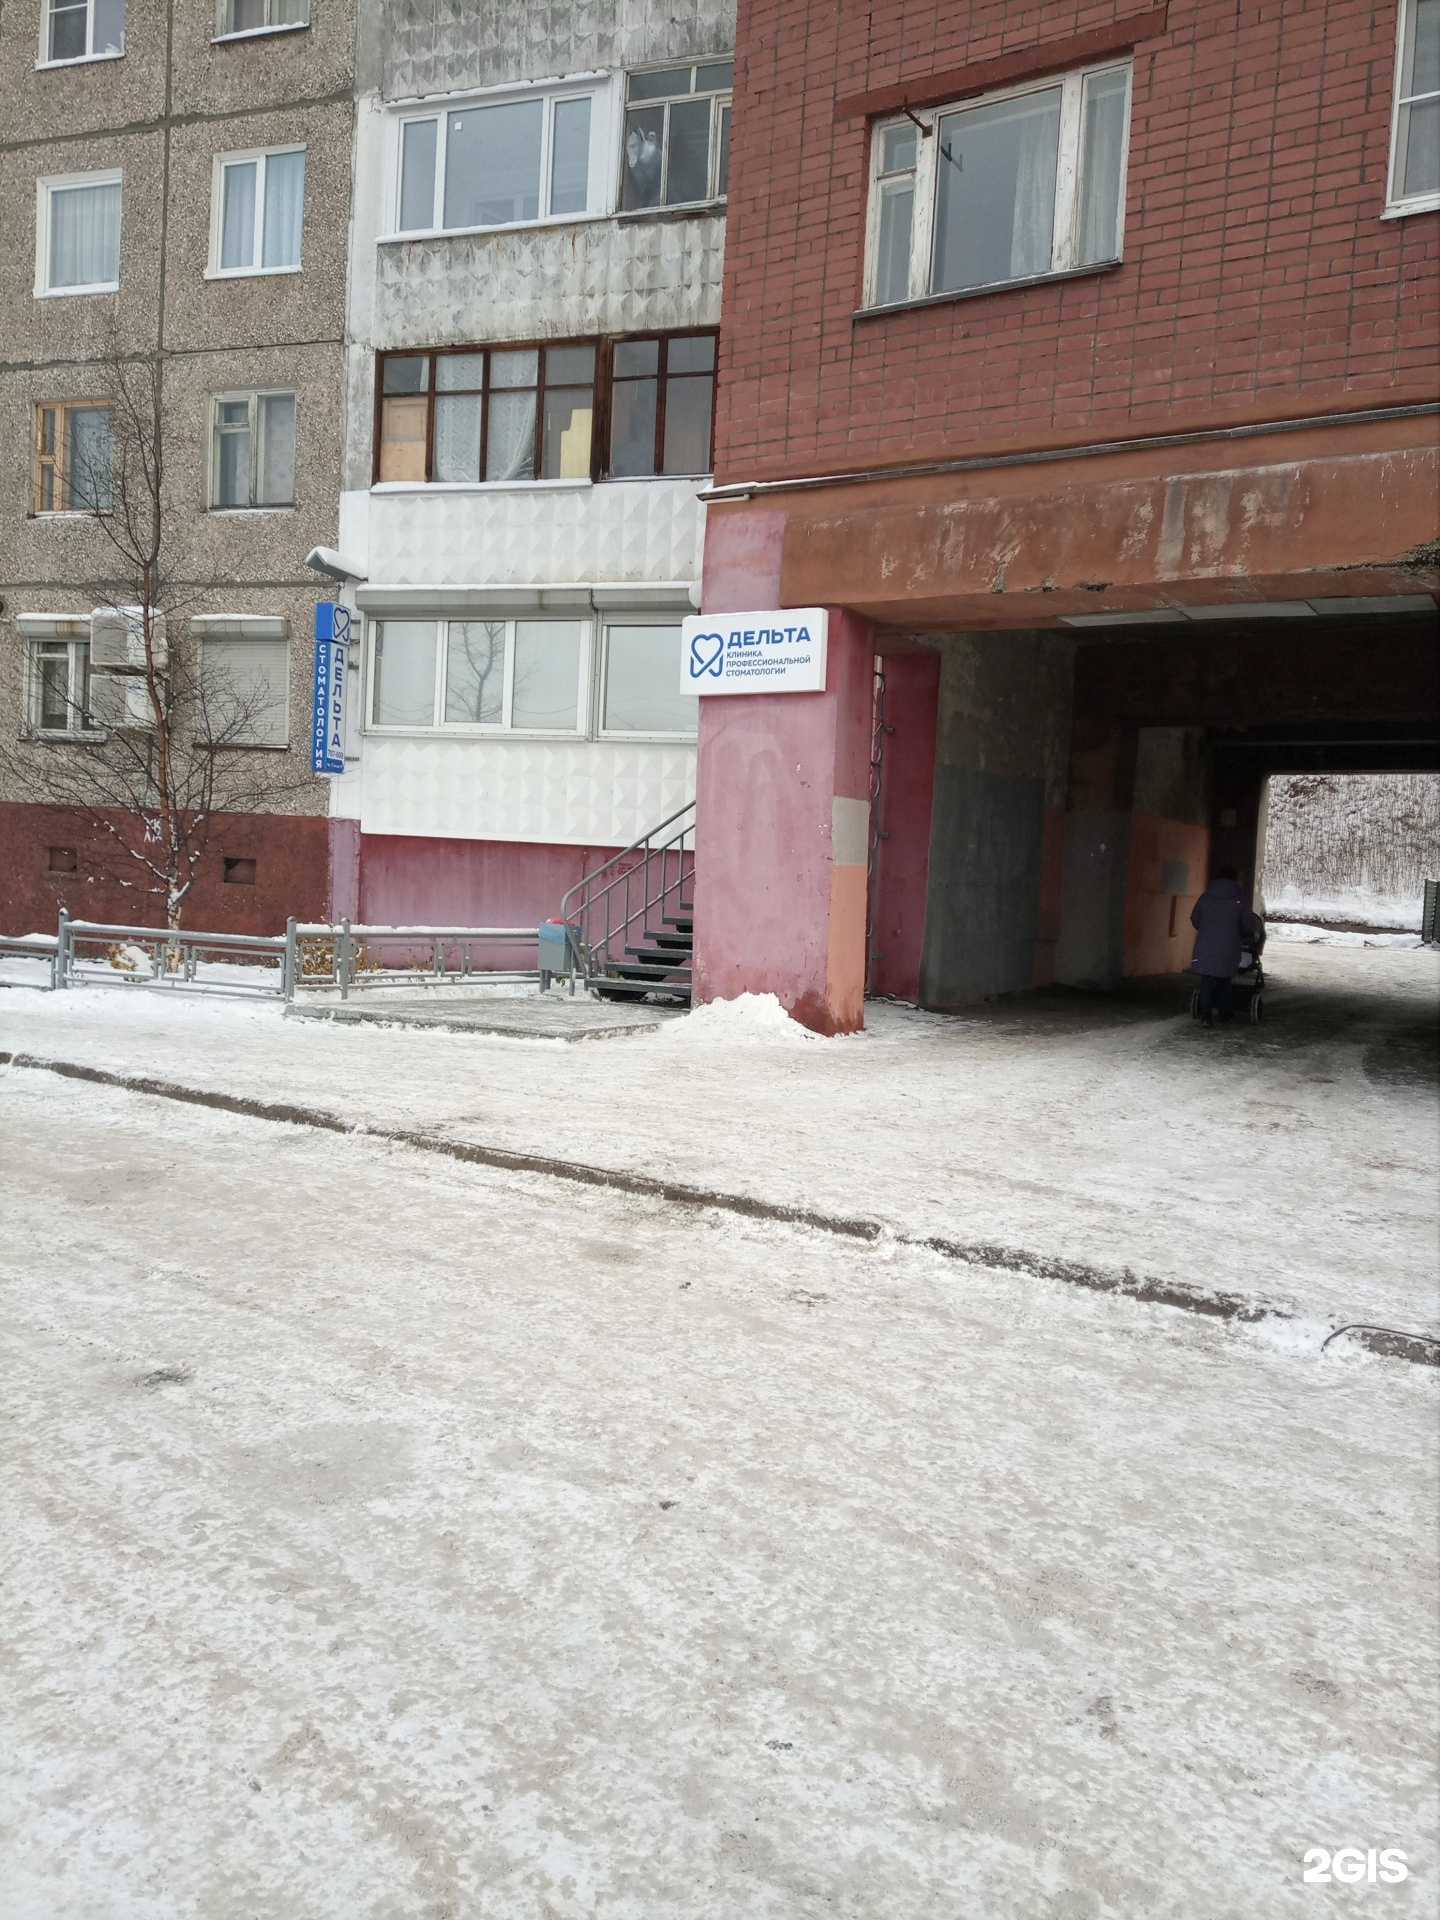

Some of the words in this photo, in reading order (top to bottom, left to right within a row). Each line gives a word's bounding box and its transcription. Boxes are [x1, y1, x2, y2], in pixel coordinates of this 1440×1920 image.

[727, 627, 811, 649] ДЕЛЬТА
[726, 650, 763, 659] КЛИНИКА
[726, 655, 811, 668] ПРОФЕССИОНАЛЬНОЙ
[726, 667, 786, 677] СТОМАТОЛОГИИ
[331, 647, 344, 748] ДЕЛЬТА
[315, 644, 327, 769] СТОМАТОЛОГИЯ
